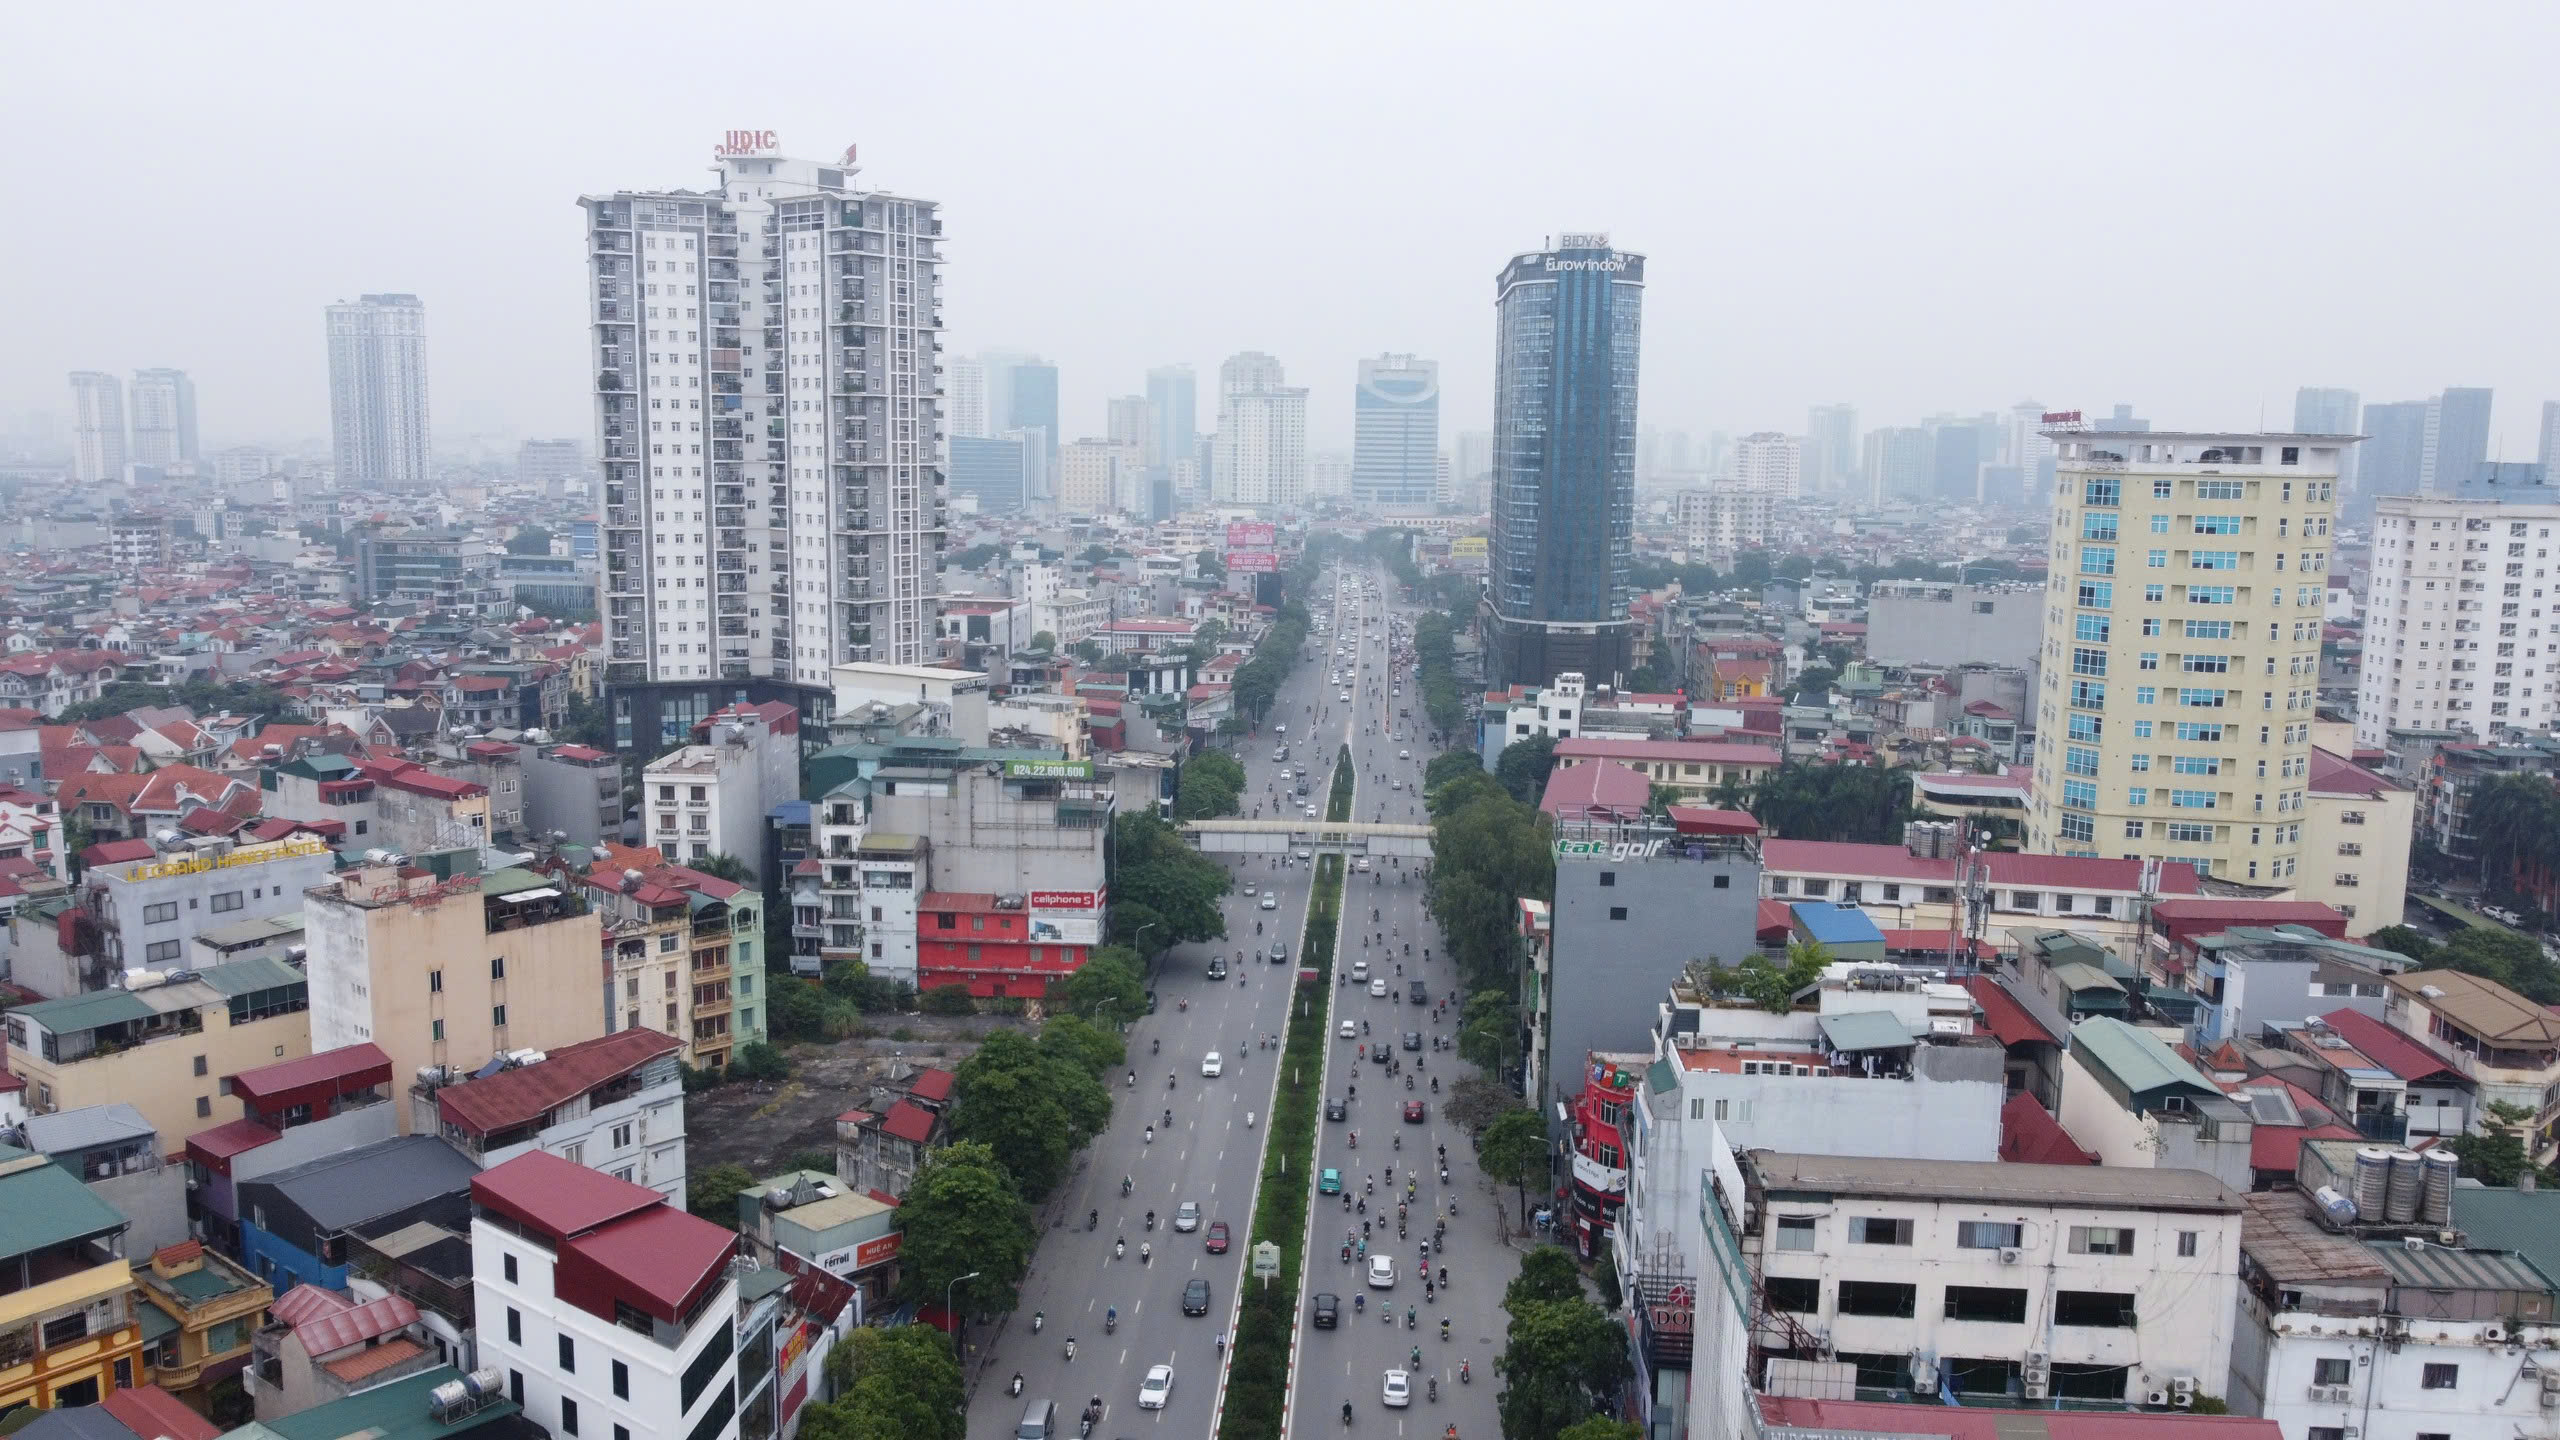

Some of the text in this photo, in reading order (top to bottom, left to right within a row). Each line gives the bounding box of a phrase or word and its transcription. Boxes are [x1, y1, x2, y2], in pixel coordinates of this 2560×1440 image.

[726, 130, 777, 150] UDIC
[1562, 235, 1594, 248] BIDV
[1546, 257, 1626, 272] Eurowindow
[1014, 764, 1085, 777] 024.22.600.600
[1557, 838, 1664, 862] tat golf
[1033, 894, 1082, 905] cellphone
[1083, 896, 1091, 905] S
[1594, 1066, 1627, 1083] FPT
